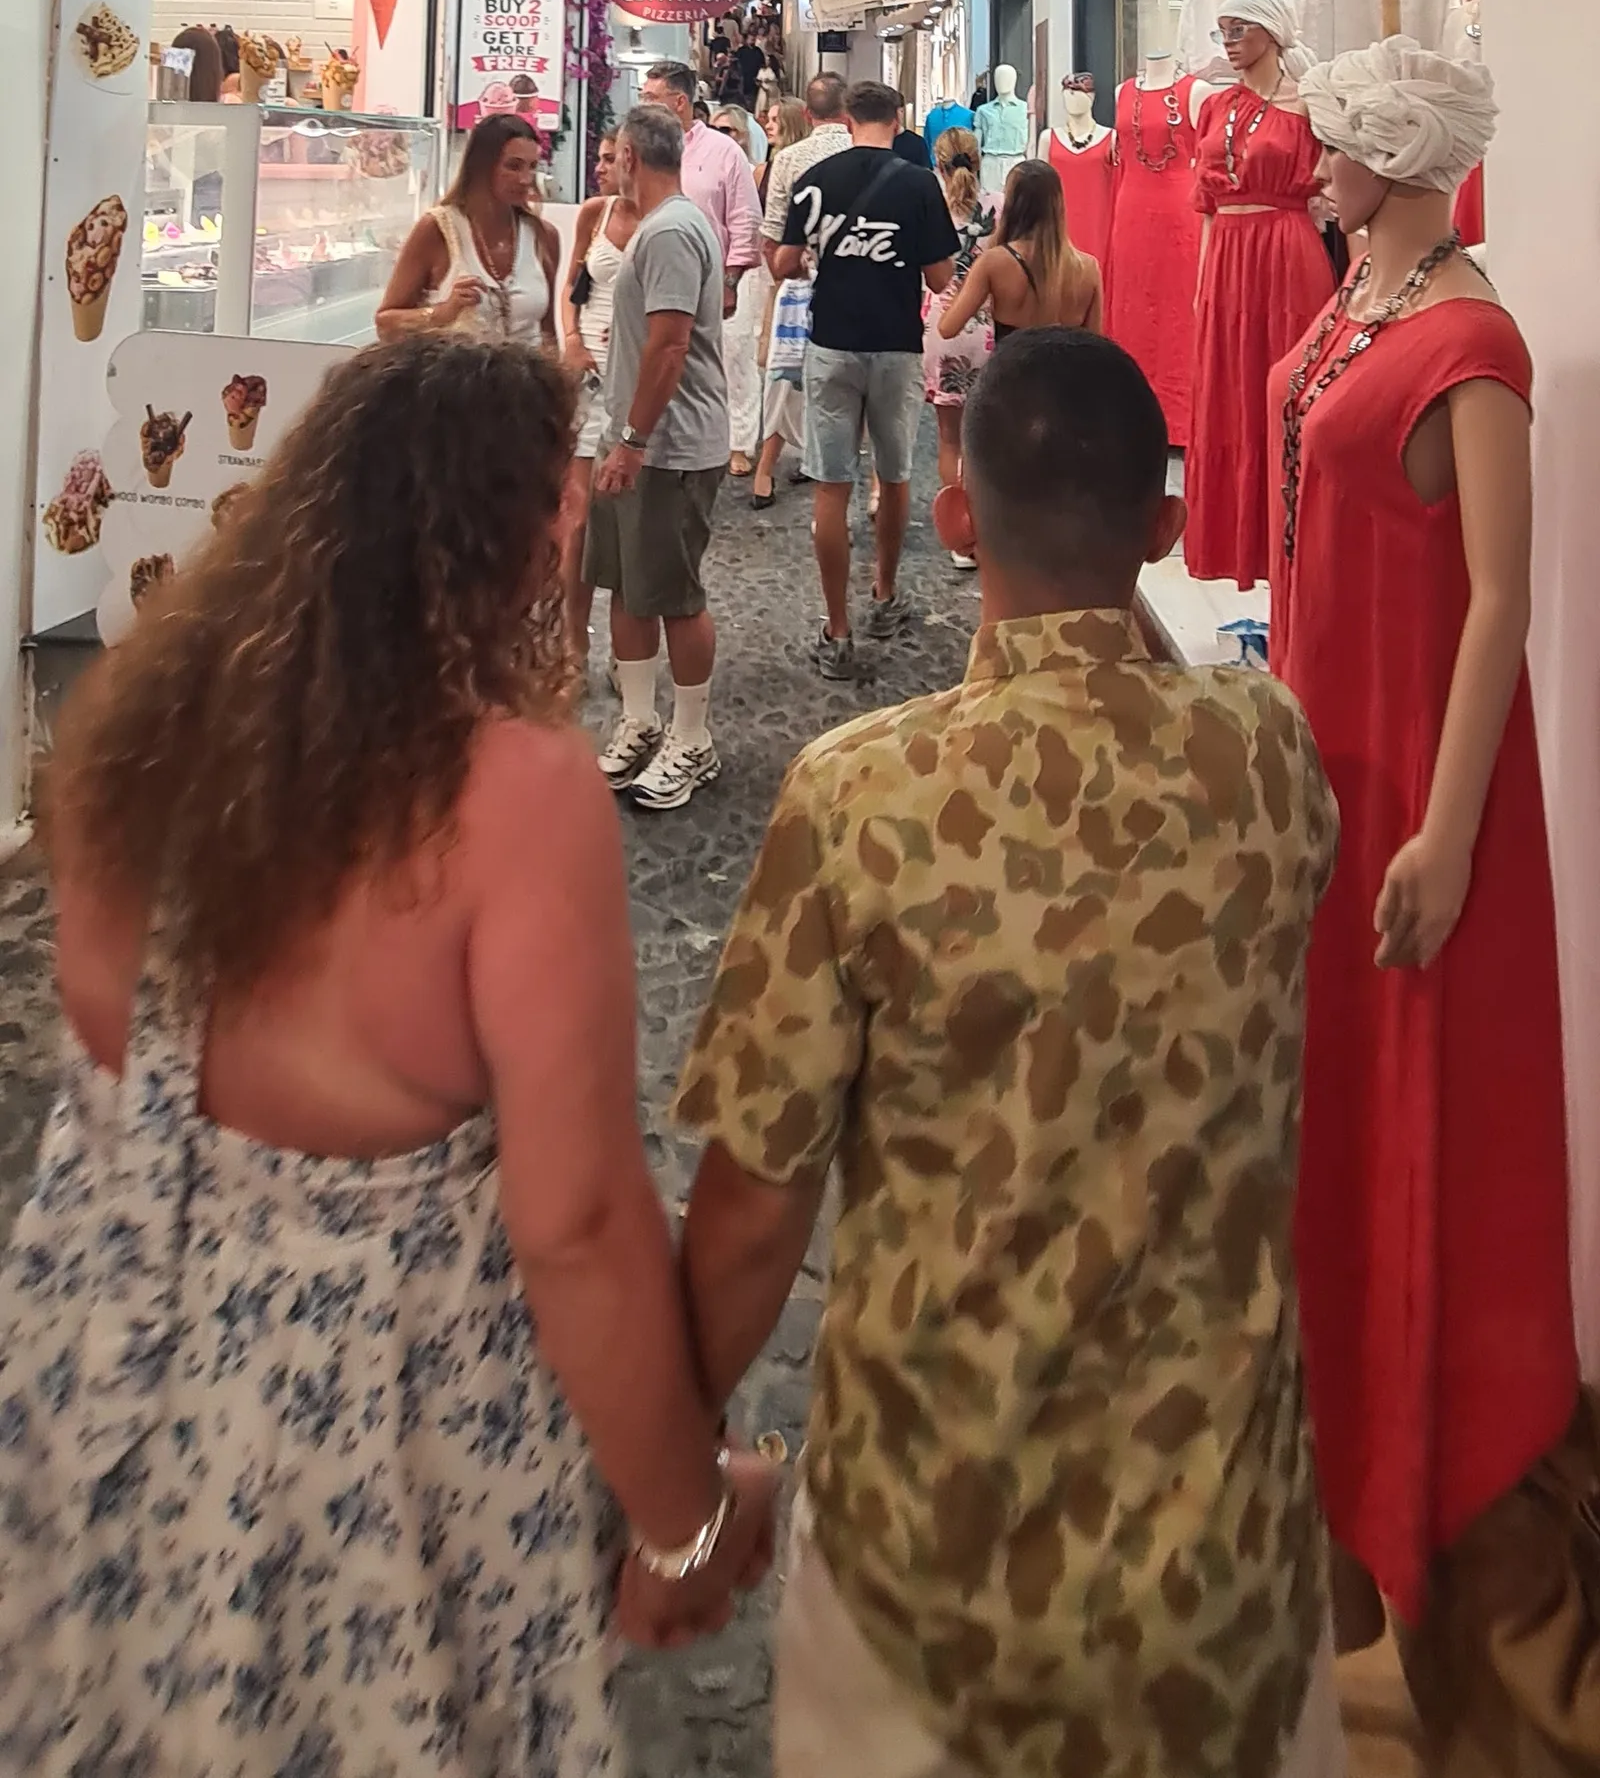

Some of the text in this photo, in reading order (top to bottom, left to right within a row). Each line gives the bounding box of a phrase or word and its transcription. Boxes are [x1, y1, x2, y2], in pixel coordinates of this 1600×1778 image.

[483, 14, 541, 27] SCOOP
[641, 6, 709, 22] PIZZERIA
[482, 30, 540, 46] GET 1
[488, 45, 536, 56] MORE
[481, 55, 541, 72] FREE
